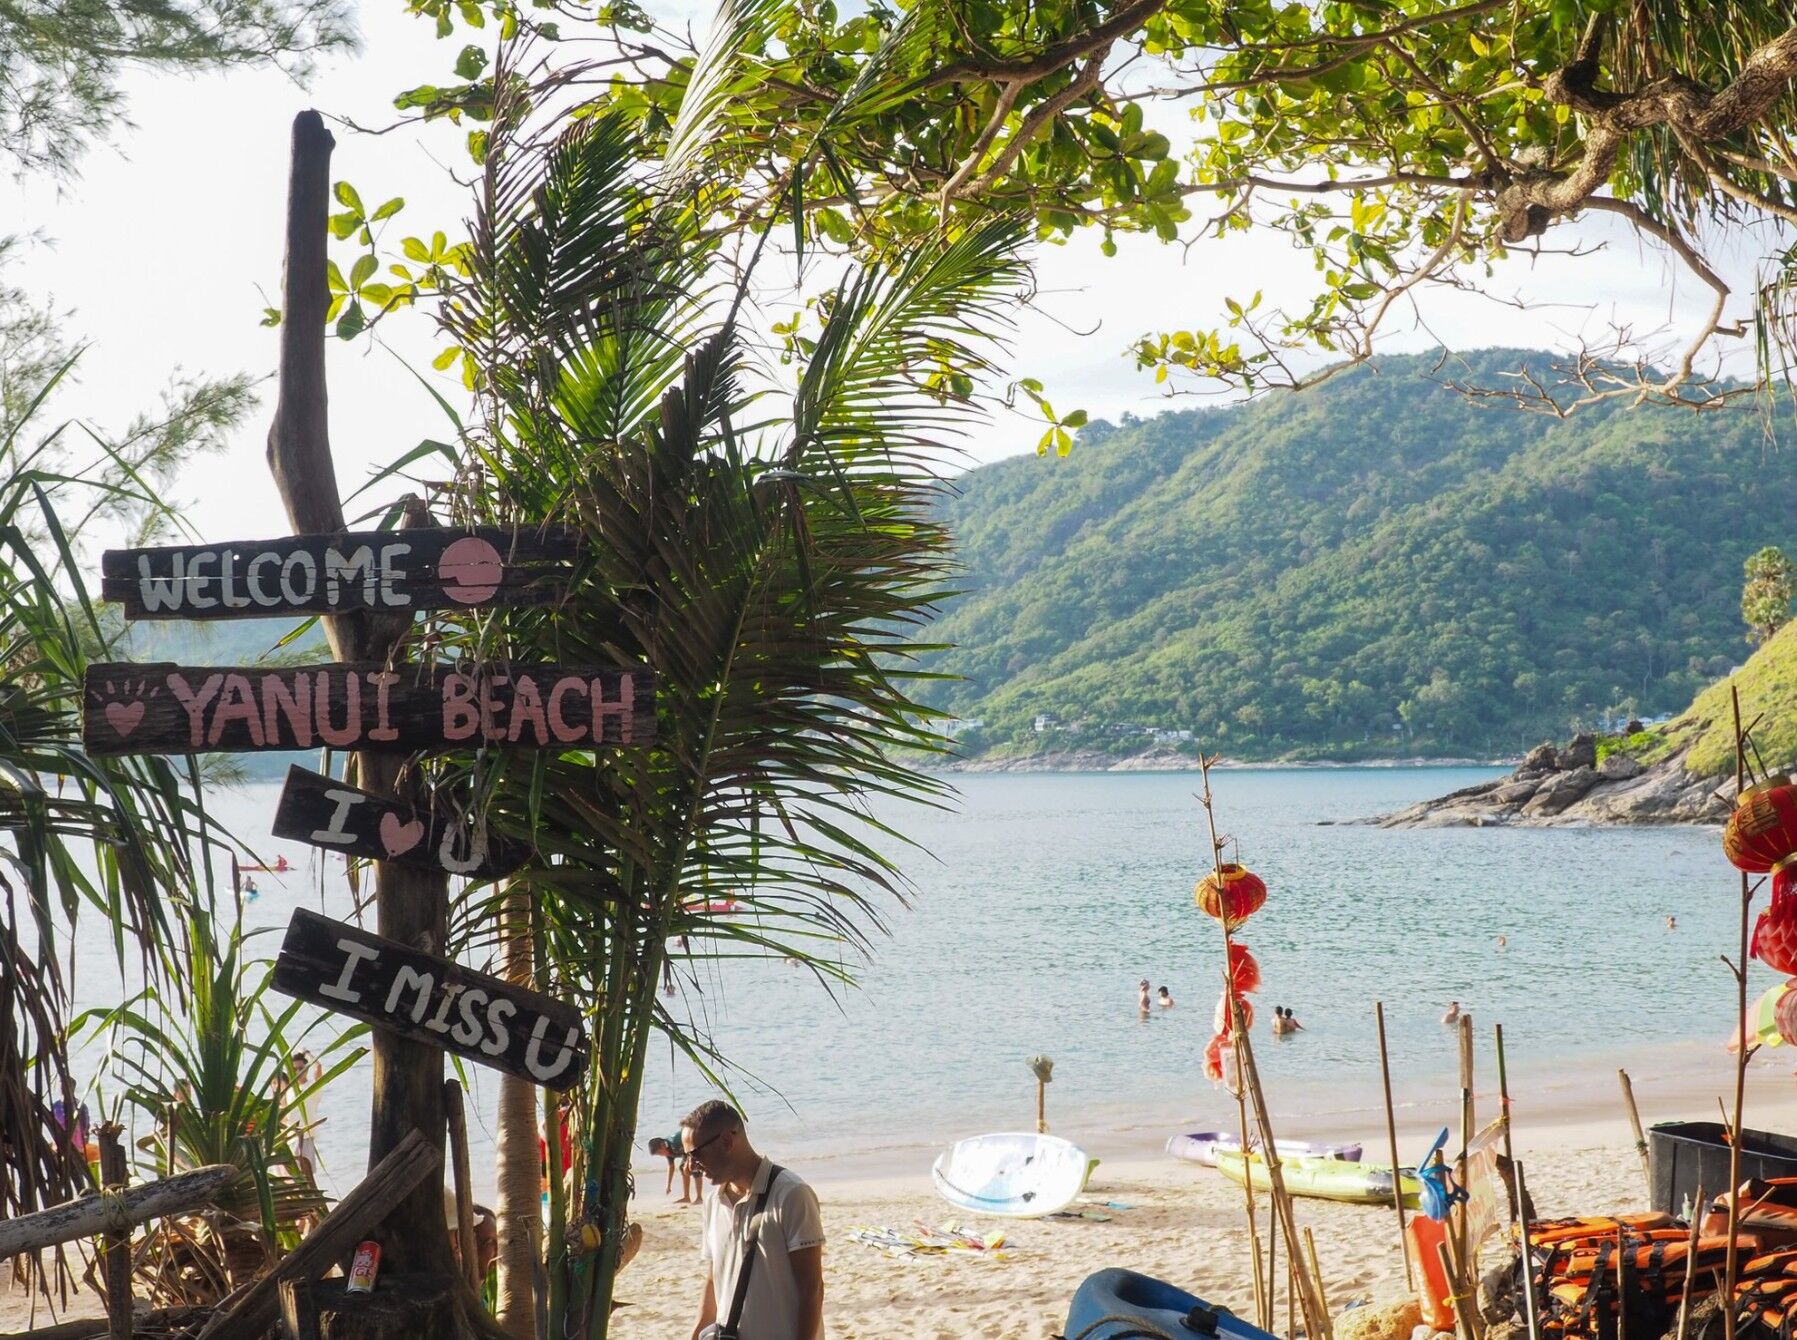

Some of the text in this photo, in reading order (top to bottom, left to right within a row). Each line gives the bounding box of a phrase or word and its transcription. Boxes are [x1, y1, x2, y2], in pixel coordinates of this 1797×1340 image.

[138, 543, 411, 611] WELCOME
[167, 672, 634, 746] YANUI BEACH
[311, 790, 488, 873] I U
[319, 938, 578, 1080] I MISS U
